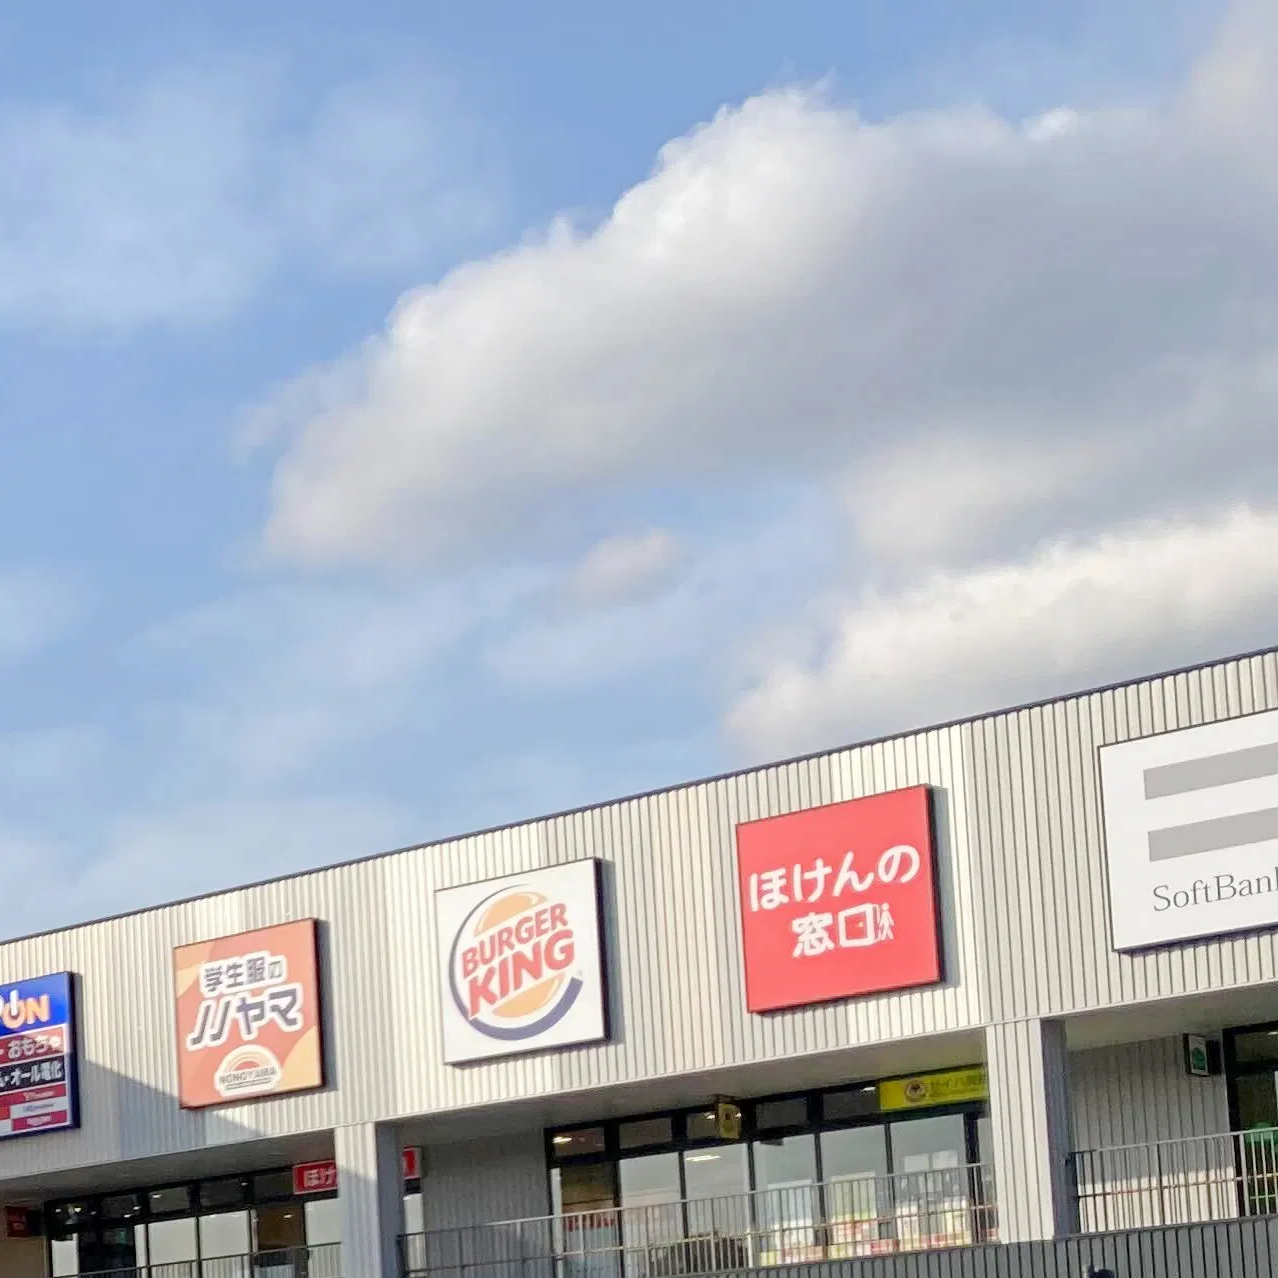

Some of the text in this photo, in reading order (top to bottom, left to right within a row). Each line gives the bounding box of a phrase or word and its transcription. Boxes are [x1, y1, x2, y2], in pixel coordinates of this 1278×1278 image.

[749, 844, 921, 912] ほけんの
[461, 902, 570, 980] BURGER
[791, 902, 880, 958] 窓口
[204, 956, 284, 994] 学生服の
[468, 928, 576, 1019] KING
